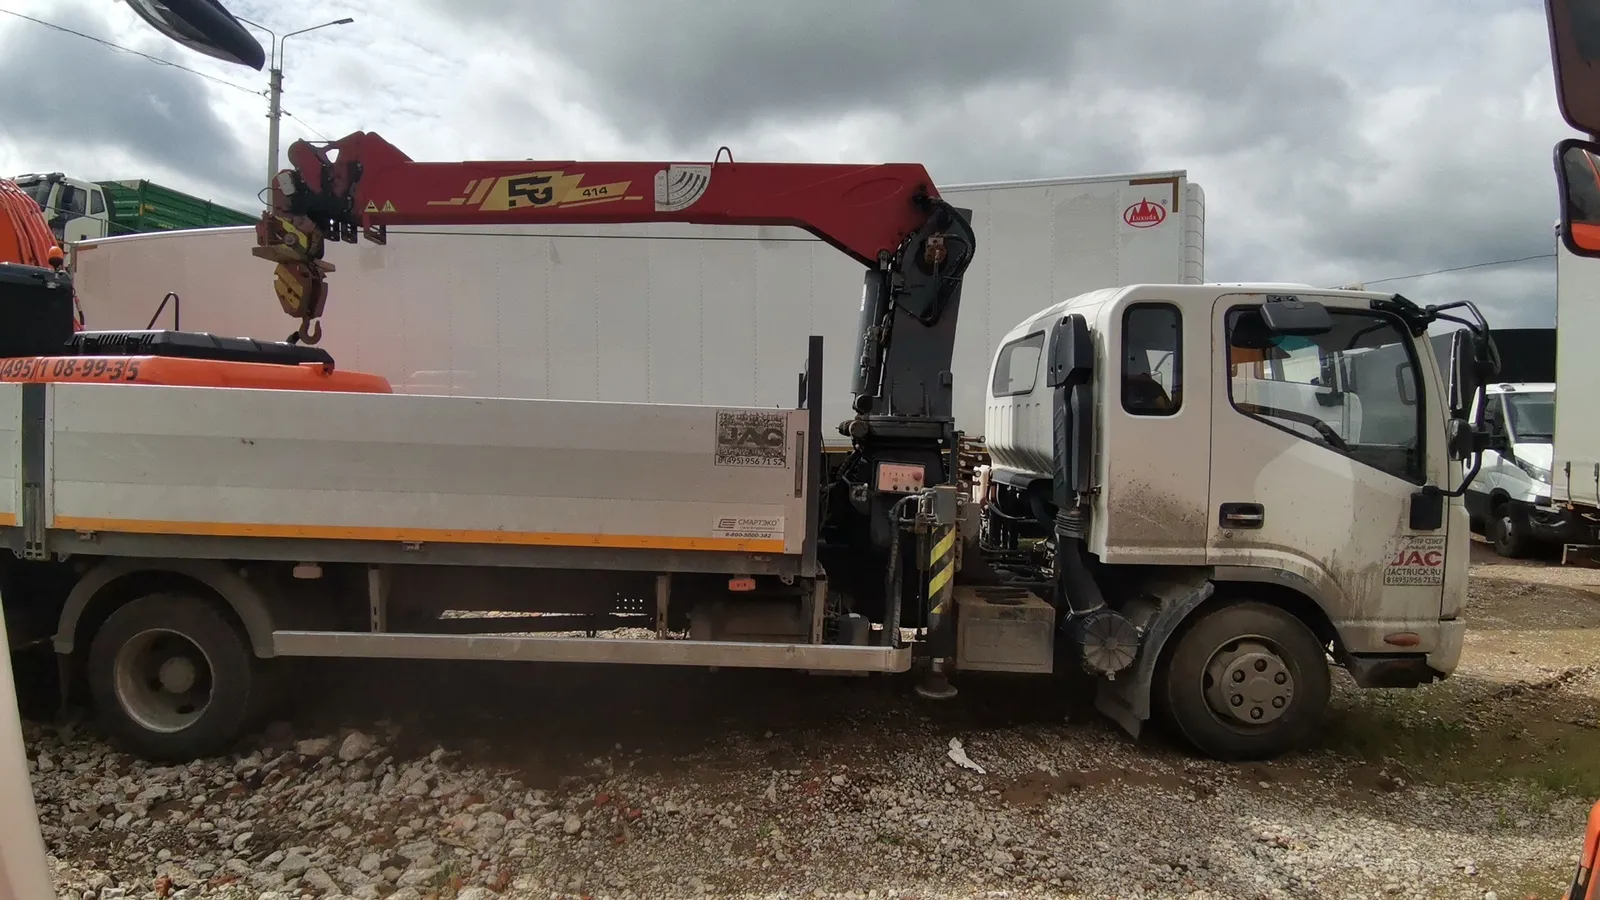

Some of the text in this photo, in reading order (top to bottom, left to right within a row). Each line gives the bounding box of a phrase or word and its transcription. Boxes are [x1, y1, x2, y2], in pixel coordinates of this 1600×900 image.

[582, 186, 608, 197] 414
[53, 358, 141, 381] 08-99-35
[718, 427, 784, 446] JAC
[725, 456, 744, 465] (495)
[745, 457, 760, 465] 956
[762, 458, 771, 466] 71
[738, 518, 777, 526] СМАРТЭКО
[1390, 550, 1442, 566] JAC
[1387, 568, 1441, 576] JACTRUCK.RU
